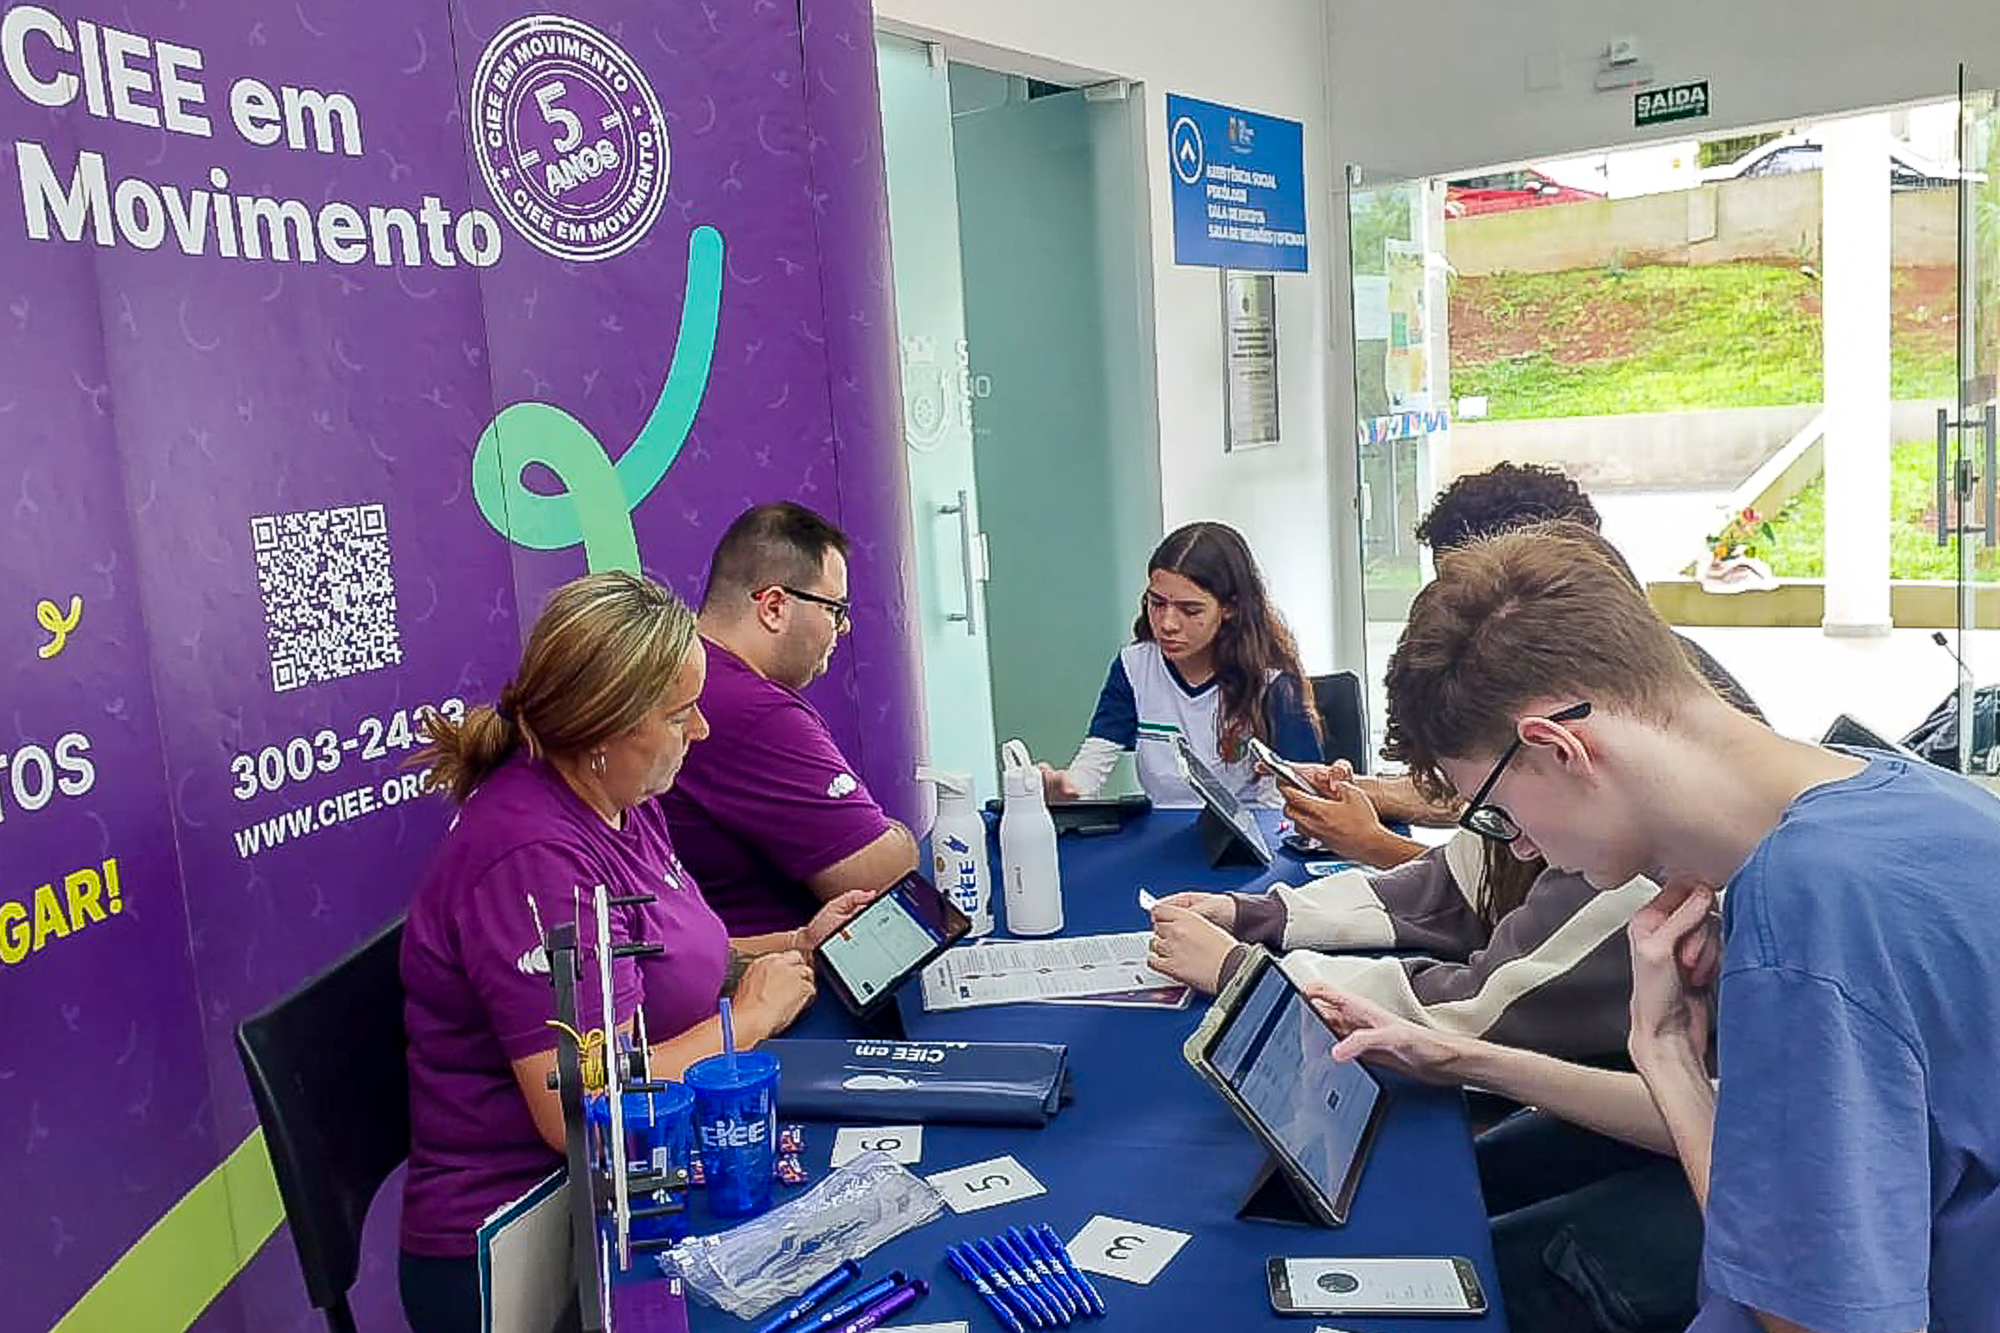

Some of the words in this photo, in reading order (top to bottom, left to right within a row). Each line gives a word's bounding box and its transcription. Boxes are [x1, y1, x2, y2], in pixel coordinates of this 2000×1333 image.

[1, 5, 212, 137] CIEE
[229, 78, 363, 156] em
[492, 56, 518, 92] EM
[513, 35, 629, 92] MOVIMENTO
[487, 92, 504, 148] CIEE
[535, 81, 583, 153] 5
[513, 188, 554, 231] CIEE
[556, 221, 586, 242] EM
[588, 131, 654, 242] MOVIMENTO
[546, 138, 620, 196] ANOS
[15, 141, 501, 267] Movimento
[0, 858, 122, 964] GAR!
[856, 1045, 889, 1056] em
[891, 1047, 945, 1062] CIEE
[965, 1175, 1010, 1193] 5
[1105, 1235, 1146, 1260] 3
